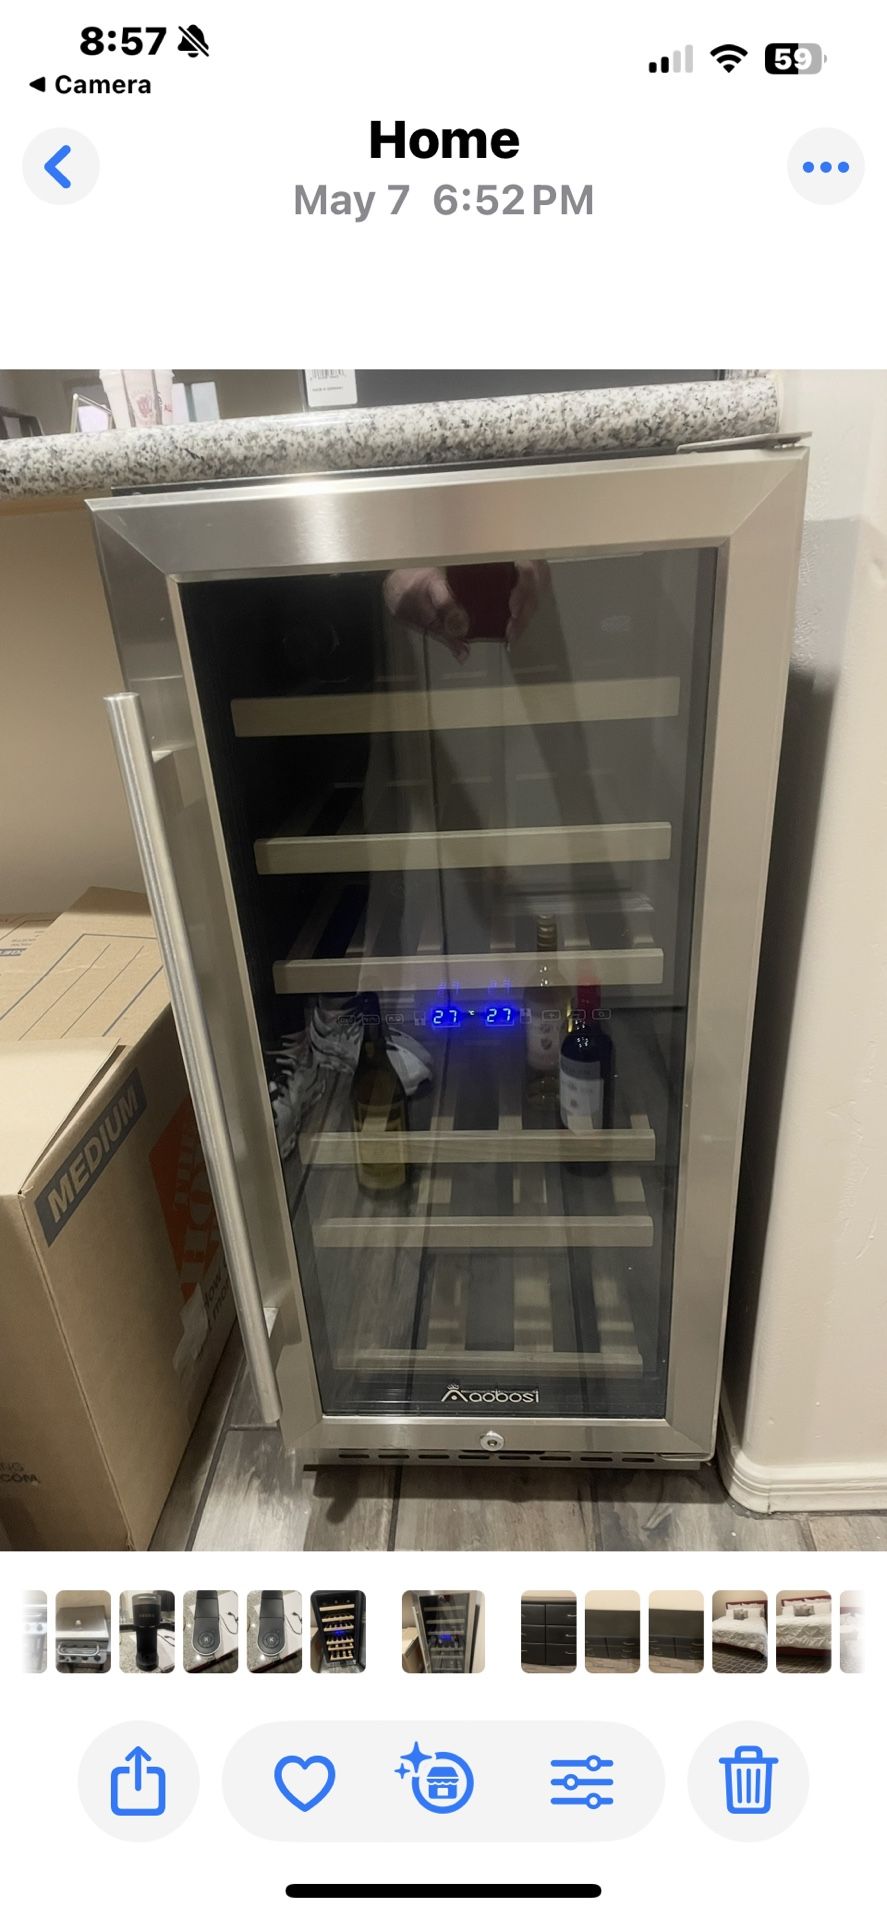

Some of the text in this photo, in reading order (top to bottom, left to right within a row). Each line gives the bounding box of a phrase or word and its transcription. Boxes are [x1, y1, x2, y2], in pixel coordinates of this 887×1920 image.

[433, 1010, 457, 1024] 27
[486, 1008, 511, 1022] 27
[46, 1085, 139, 1223] MEDIUM
